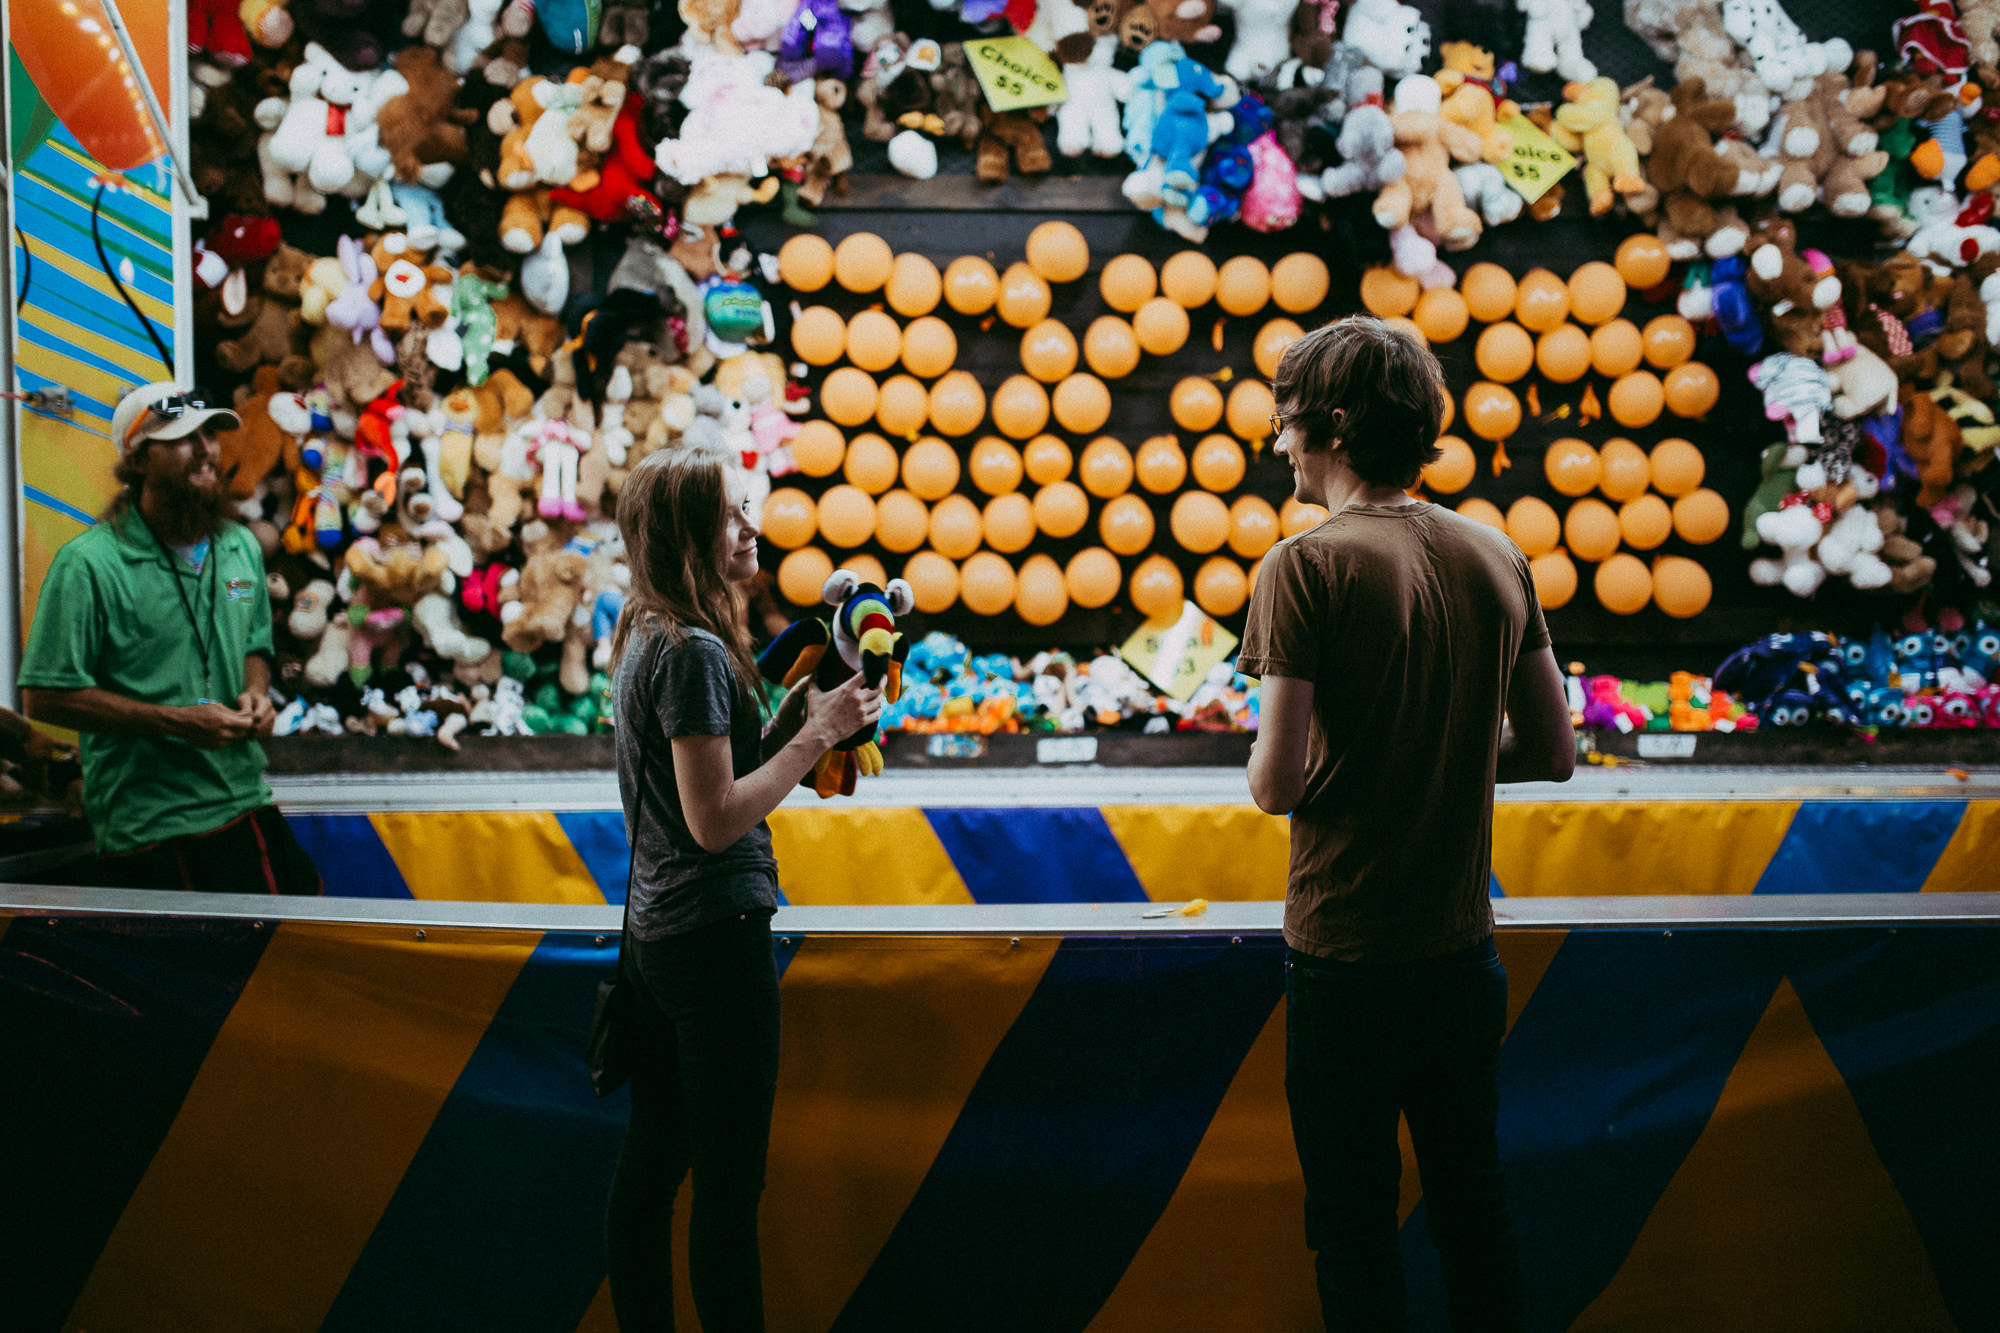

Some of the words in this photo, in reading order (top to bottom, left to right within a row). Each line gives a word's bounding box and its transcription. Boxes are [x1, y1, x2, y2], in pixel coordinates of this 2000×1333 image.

[980, 45, 1058, 91] Choice
[997, 76, 1022, 95] $5
[1514, 146, 1562, 161] oice
[1513, 164, 1540, 179] $5
